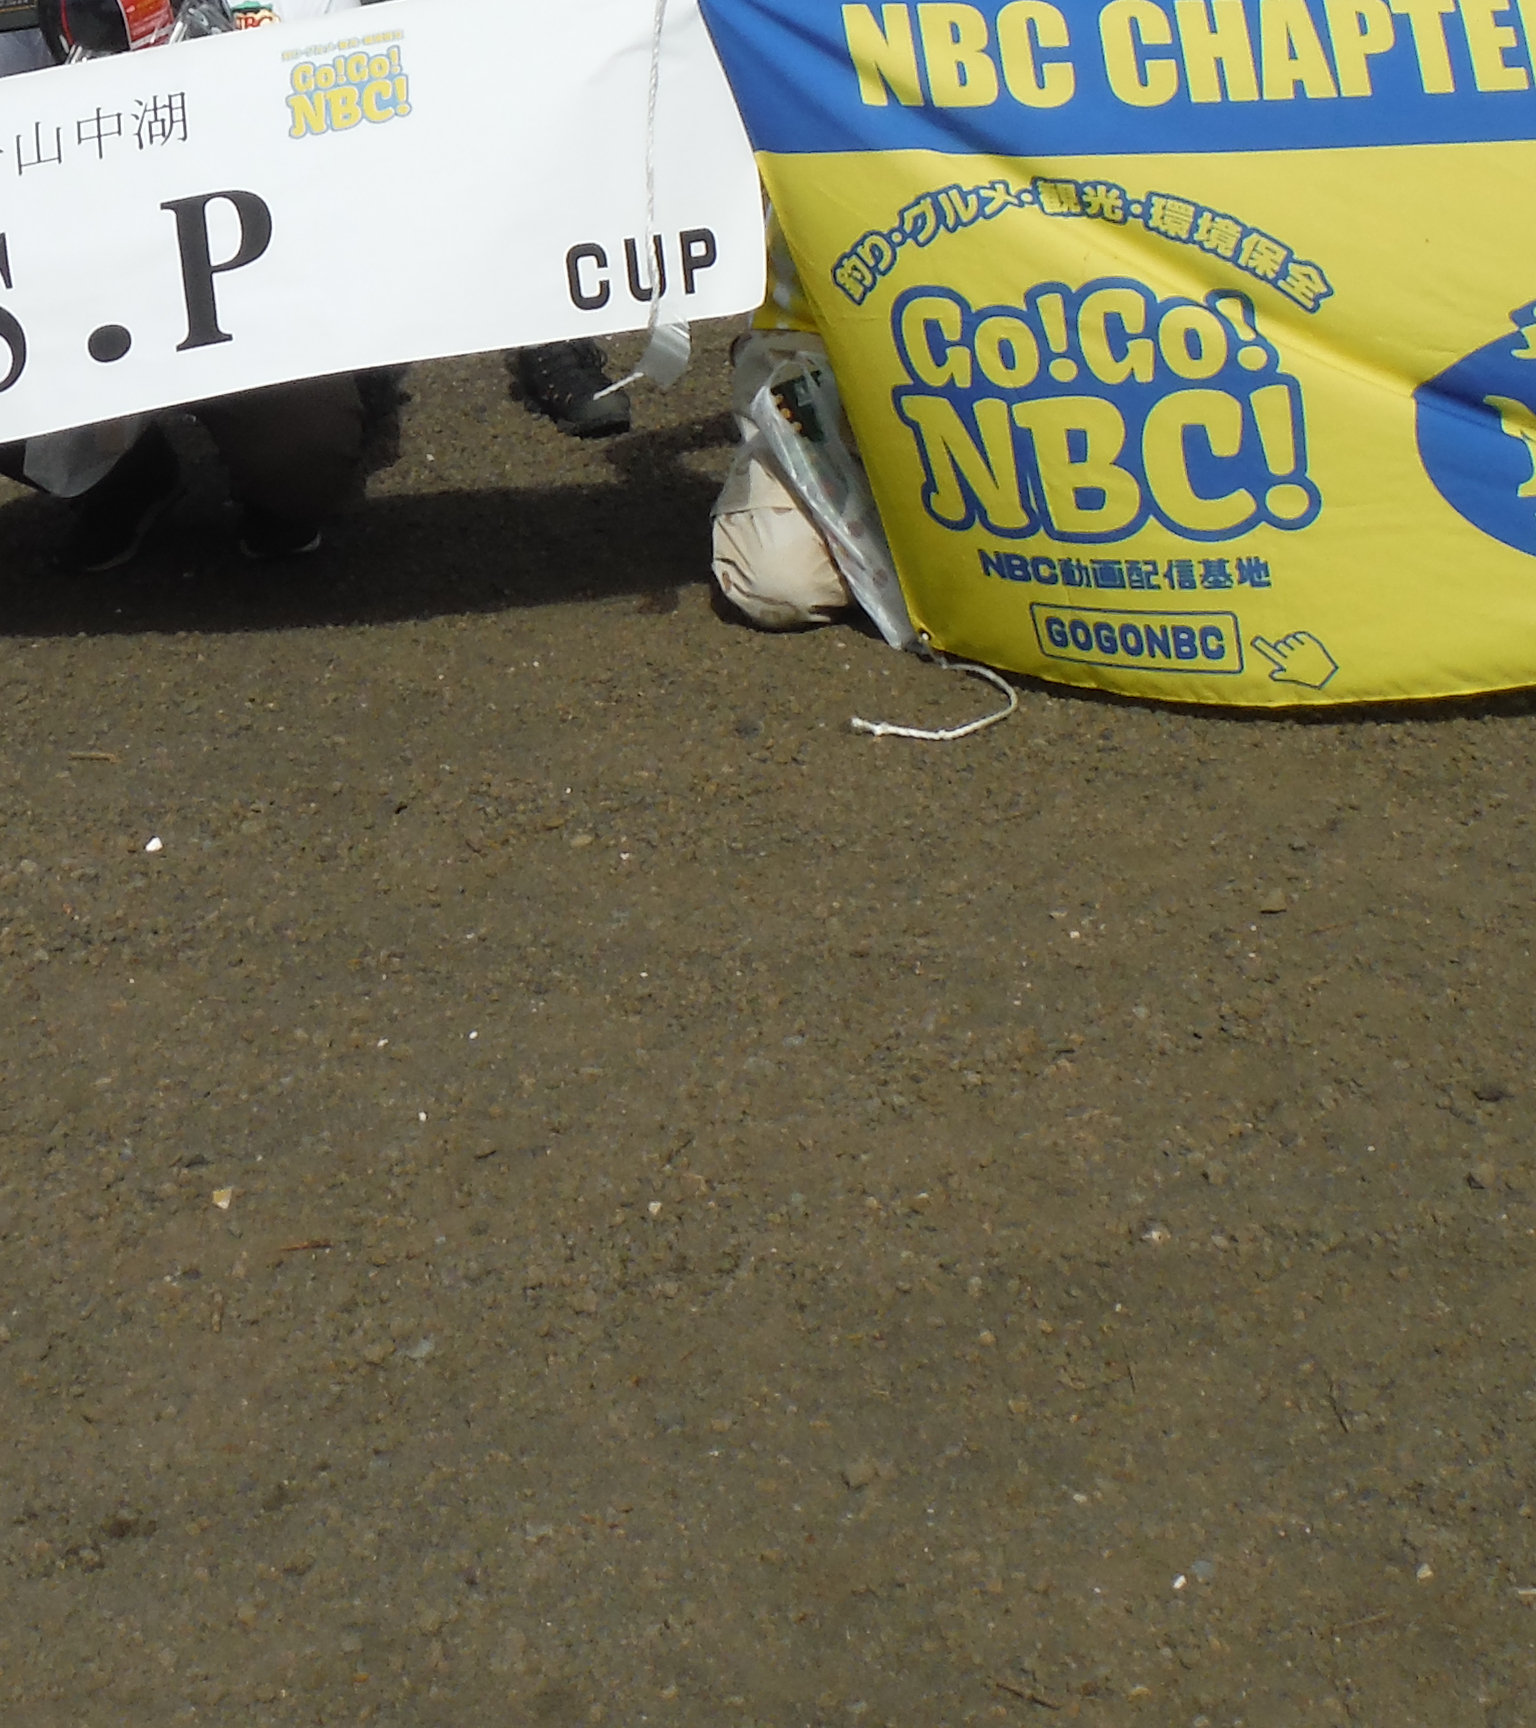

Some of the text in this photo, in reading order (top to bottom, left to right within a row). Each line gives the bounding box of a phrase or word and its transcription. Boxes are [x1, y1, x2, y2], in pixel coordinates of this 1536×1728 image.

[841, 0, 1075, 108] NBC
[287, 75, 411, 137] NBC!
[565, 228, 717, 311] CUP
[897, 281, 1276, 388] Go!Go!
[896, 380, 1317, 538] NBC!
[977, 548, 1273, 591] NBC動画配信基地
[1044, 617, 1227, 662] GOGONBC
